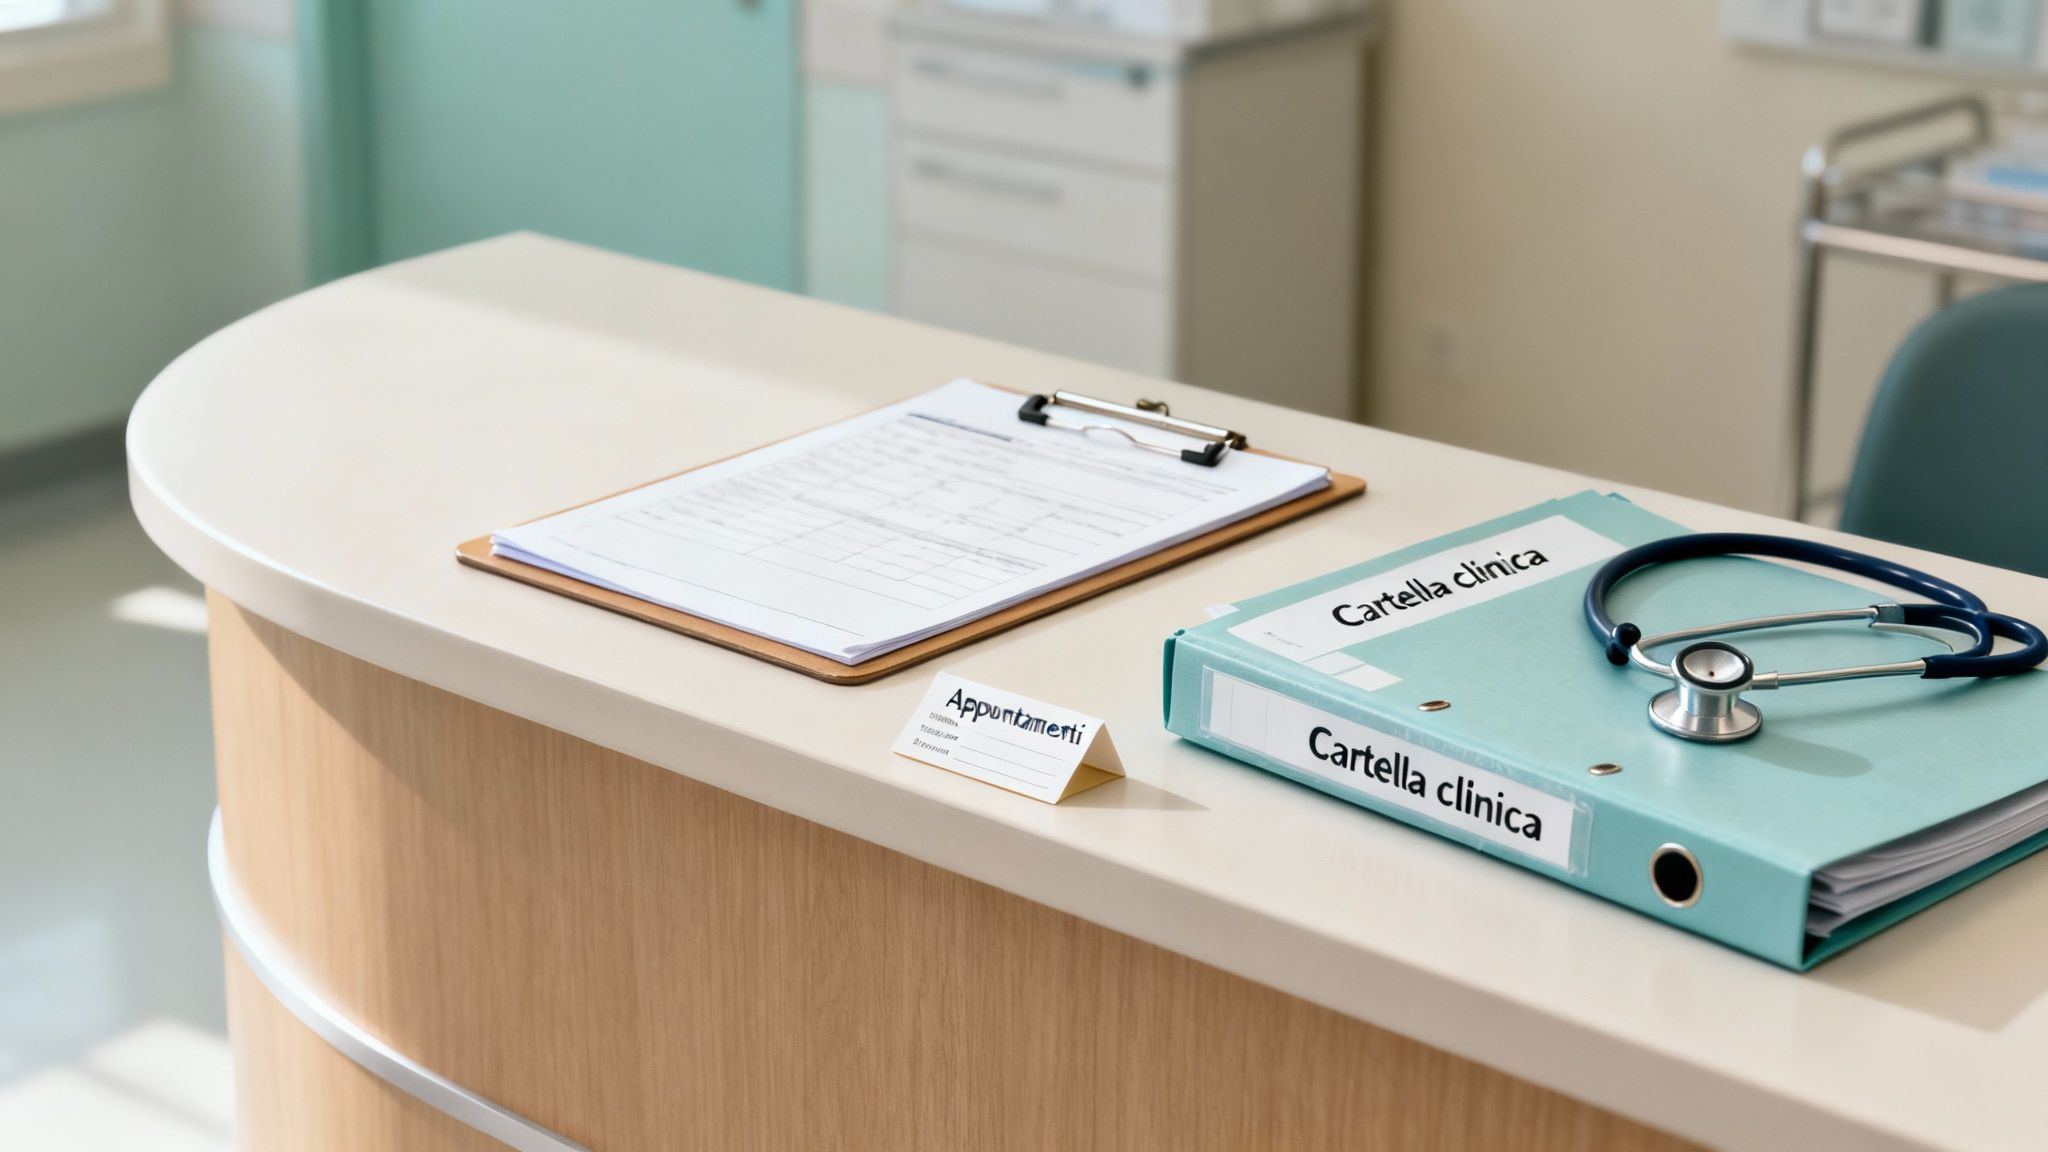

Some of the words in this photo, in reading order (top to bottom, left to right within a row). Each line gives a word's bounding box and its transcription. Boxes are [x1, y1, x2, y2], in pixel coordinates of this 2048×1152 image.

[1331, 577, 1454, 628] Cartella
[1452, 548, 1550, 590] clinica
[1307, 725, 1427, 799] Cartella
[1435, 775, 1543, 842] clinica
